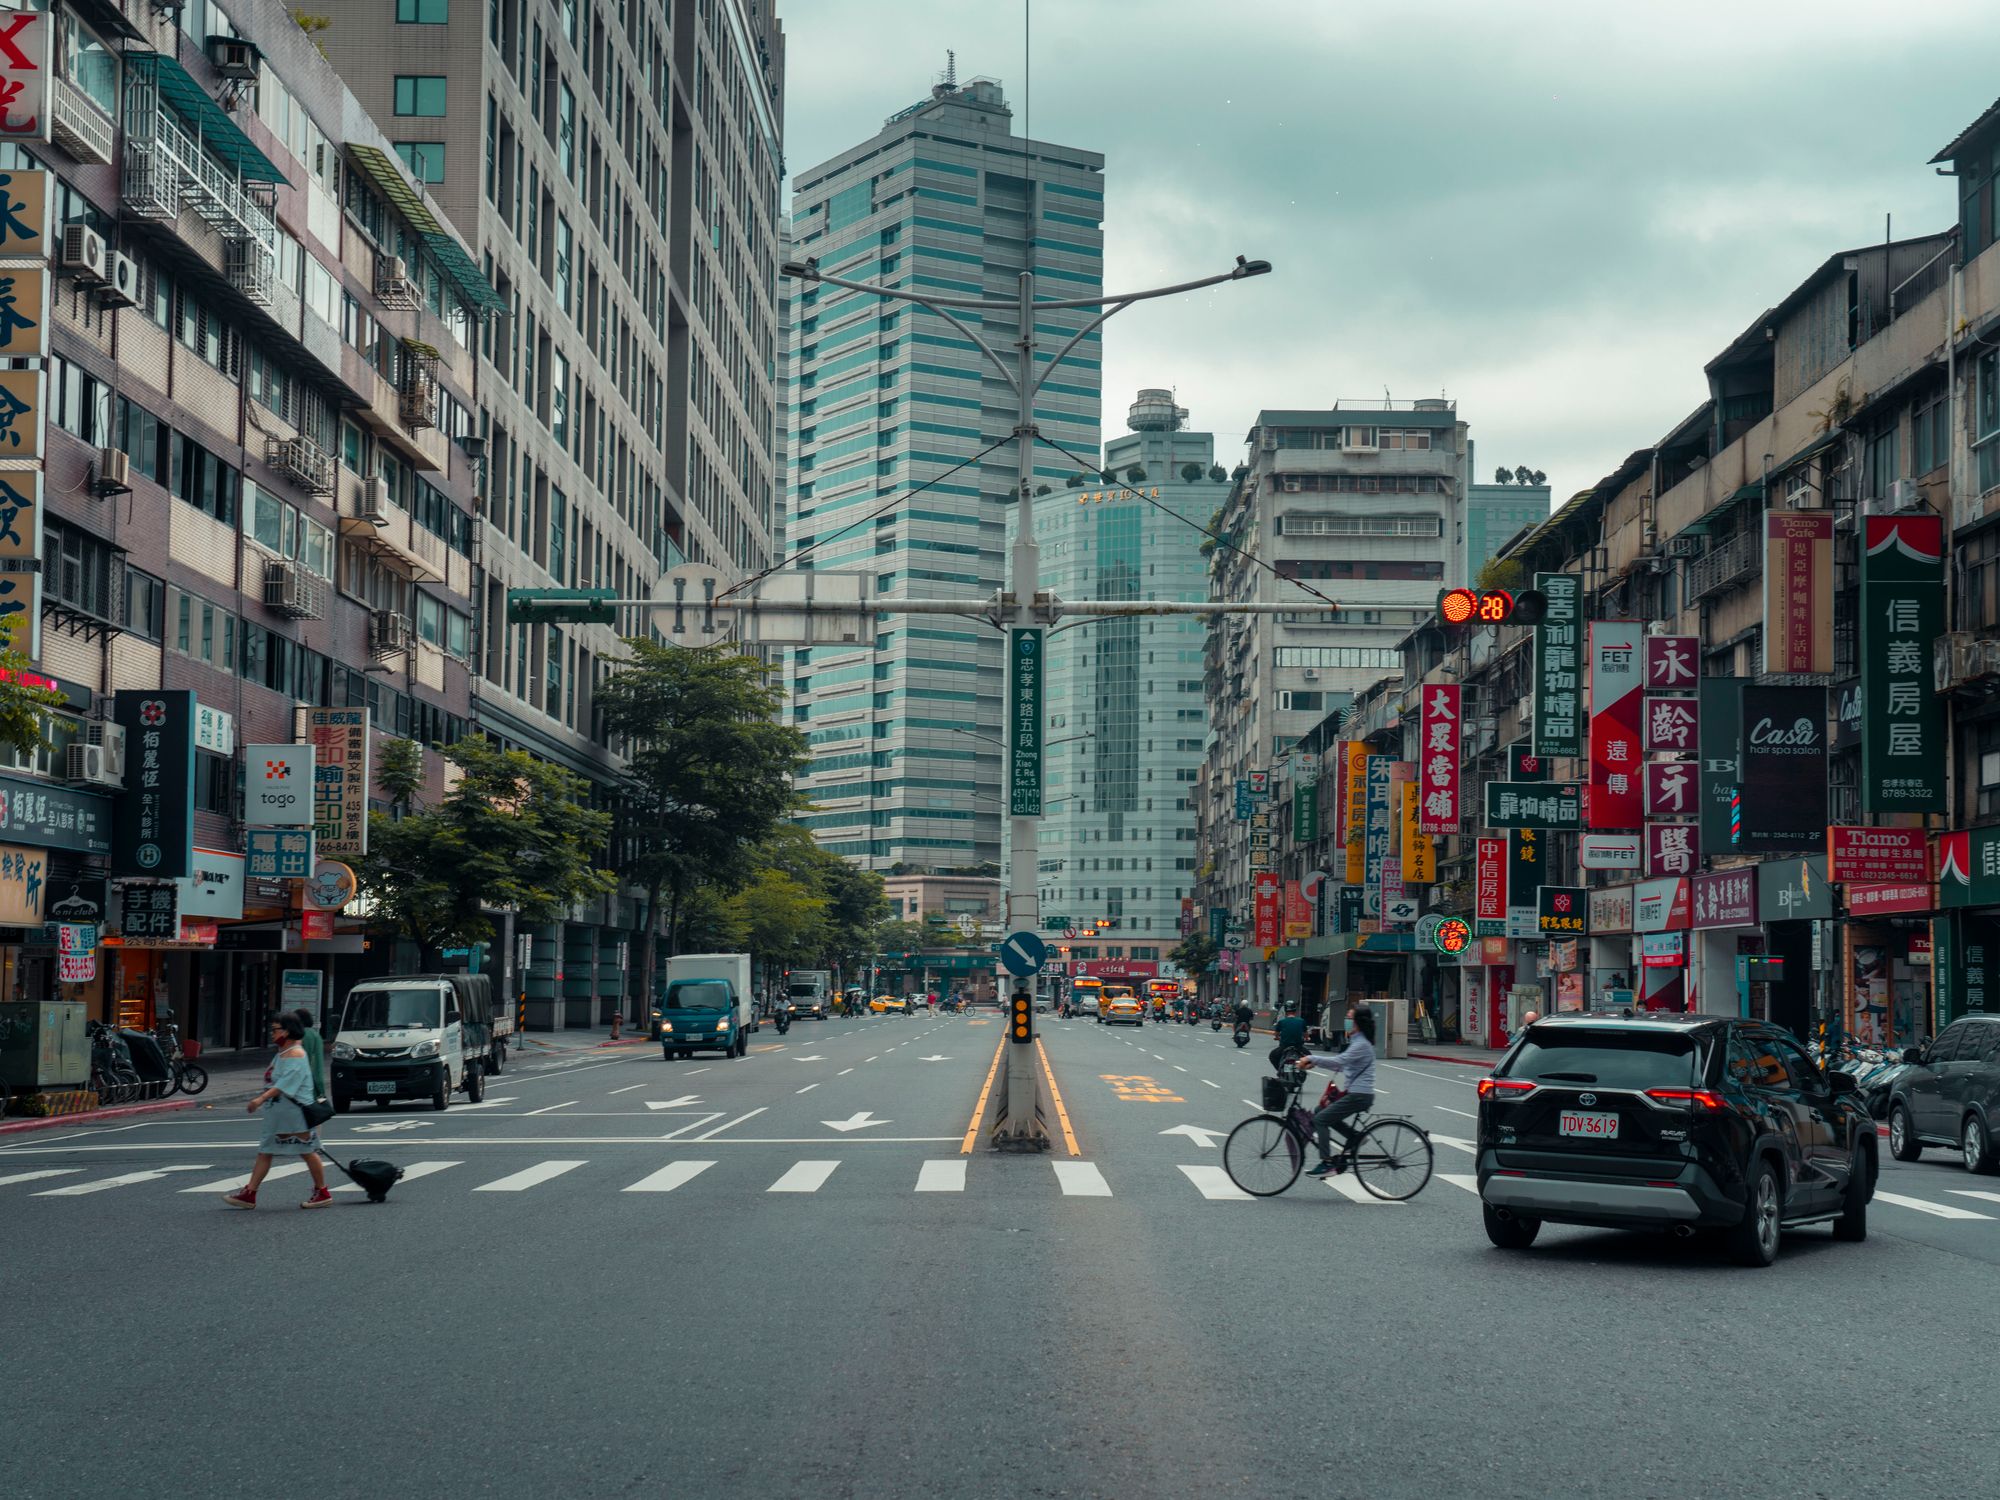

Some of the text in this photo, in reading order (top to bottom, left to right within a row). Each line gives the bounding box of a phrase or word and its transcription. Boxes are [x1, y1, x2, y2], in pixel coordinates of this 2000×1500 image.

[1781, 518, 1819, 528] Tiamo
[1786, 528, 1815, 538] Cafe
[1480, 597, 1503, 619] 28
[1543, 578, 1576, 737] 金吉利寵物精品
[1602, 652, 1632, 662] FET
[1885, 599, 1922, 755] 信義房屋
[1020, 658, 1034, 747] 忠孝東路五段
[1750, 718, 1819, 745] Casa
[1015, 750, 1037, 761] Zhong
[1652, 640, 1696, 874] 永齡牙醫
[1750, 745, 1821, 756] hair spa salon
[1015, 760, 1032, 768] Xiao
[1607, 740, 1628, 795] 遠傳
[314, 727, 345, 839] 影印輸出印刷
[261, 792, 295, 808] togo
[1882, 789, 1933, 798] 8789-3322
[141, 794, 153, 839] 全人診所
[1028, 805, 1040, 813] 422
[1500, 792, 1577, 823] 寵物精品
[1809, 831, 1821, 840] 2F
[1846, 830, 1910, 847] Tiamo
[1613, 851, 1635, 860] FET
[1982, 840, 2000, 877] 信
[1480, 841, 1499, 915] 中信房屋
[128, 889, 171, 910] 手機
[74, 907, 94, 915] club
[126, 912, 171, 932] 配件
[1540, 917, 1583, 931] 寶島眼鏡
[1967, 945, 1984, 1014] 信義房
[1562, 1116, 1617, 1134] TDV-3619
